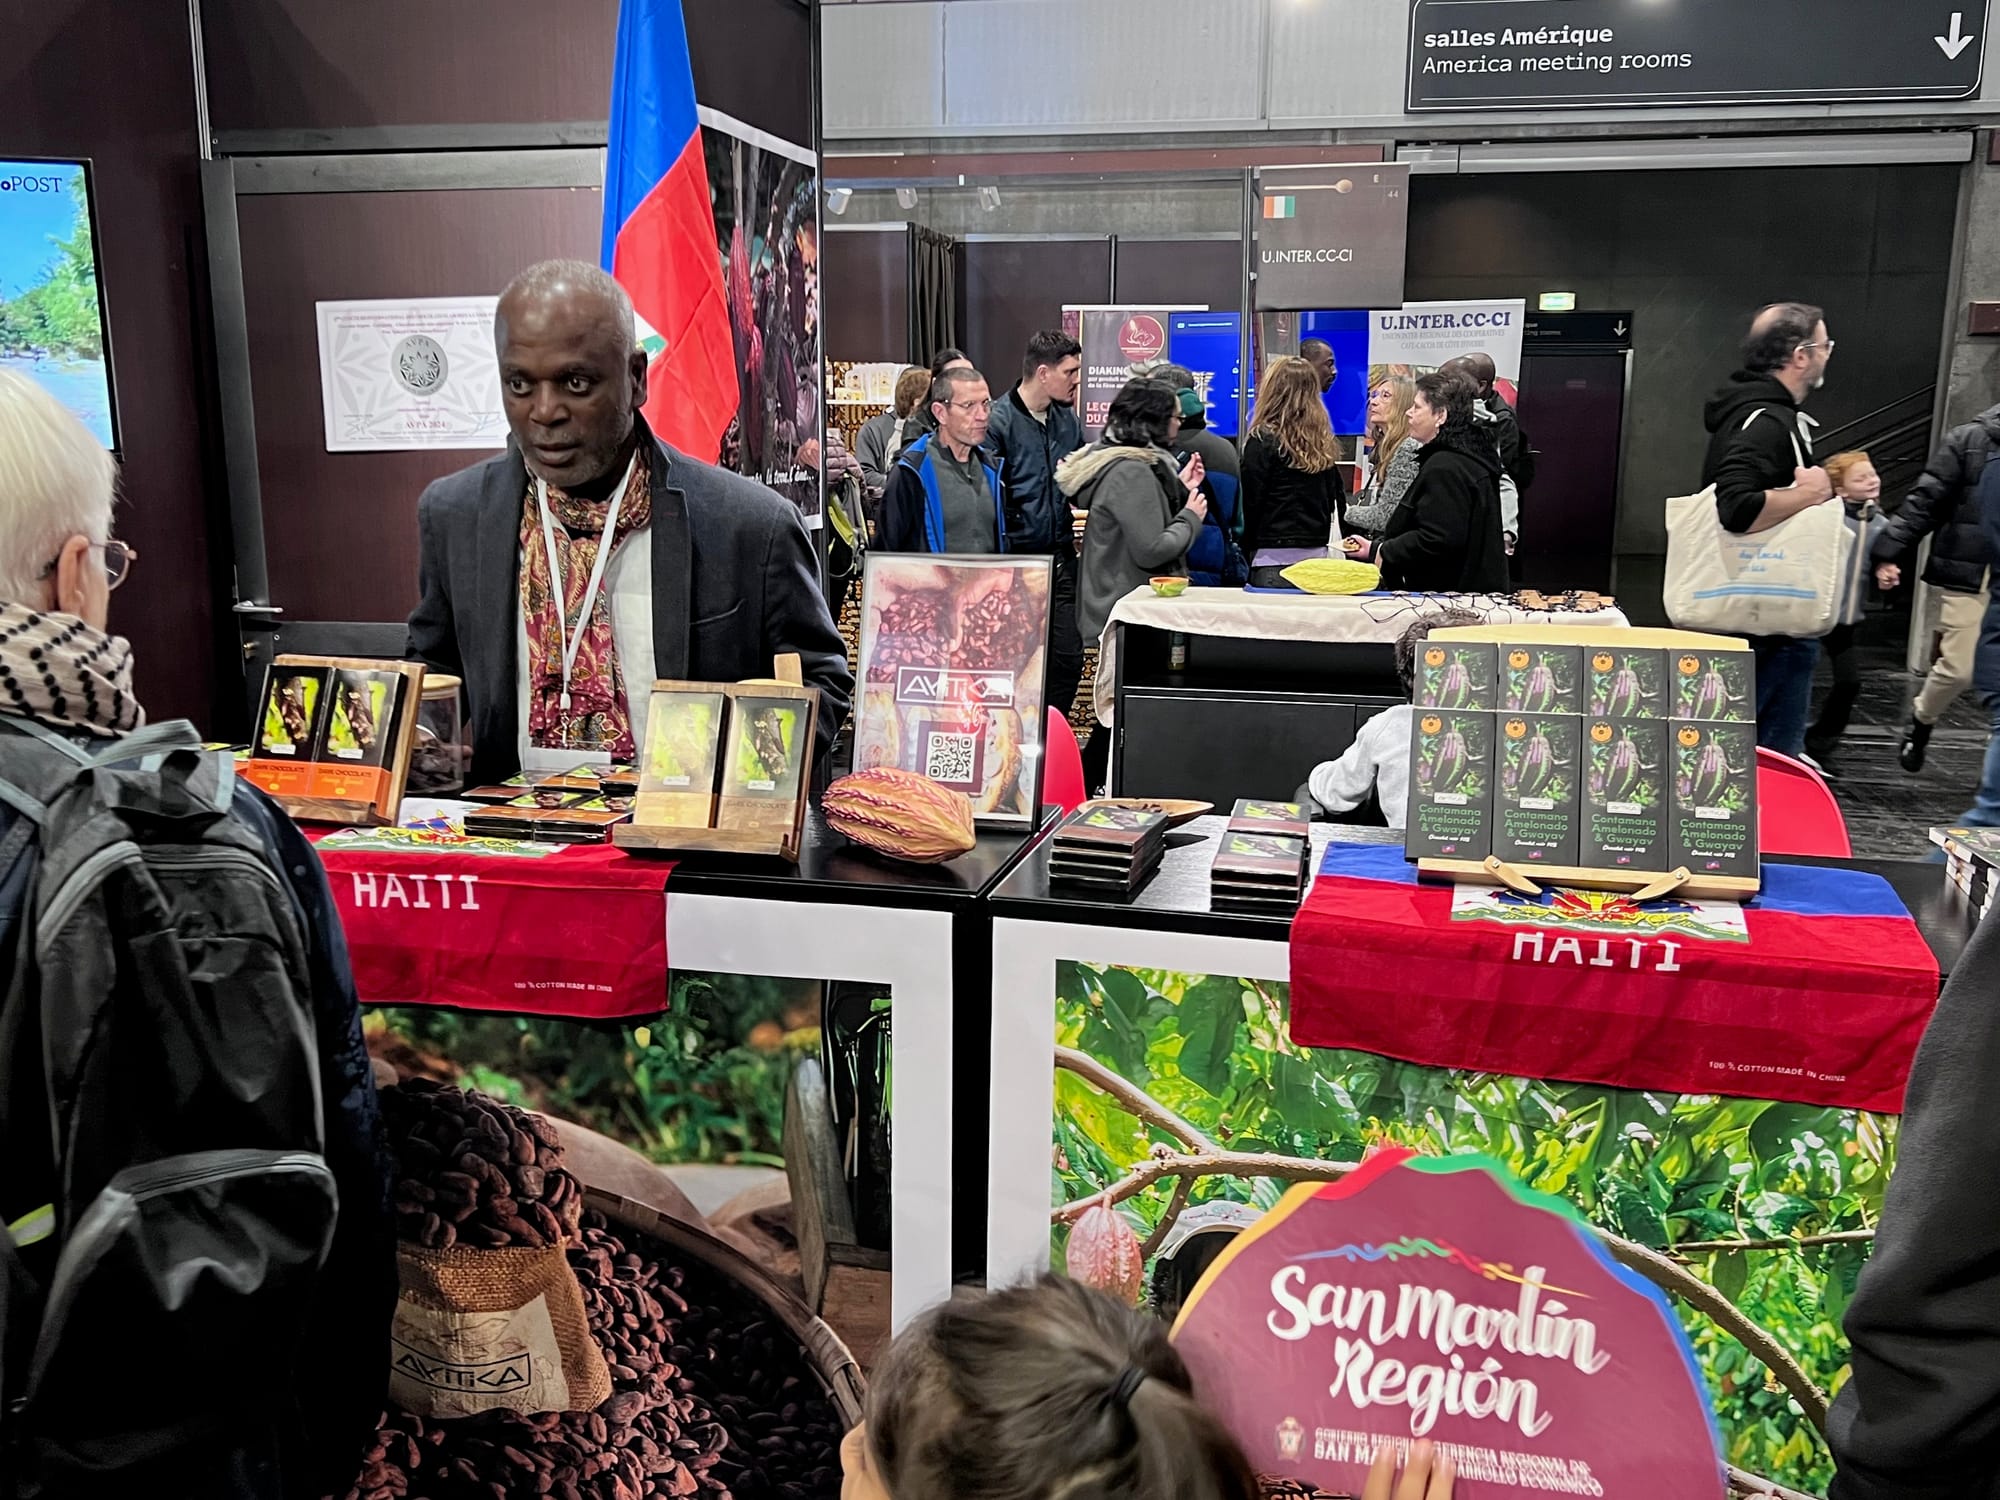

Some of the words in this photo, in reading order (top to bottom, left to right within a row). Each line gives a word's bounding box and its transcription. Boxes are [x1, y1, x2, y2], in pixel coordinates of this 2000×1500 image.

[1424, 29, 1496, 48] salles
[1500, 25, 1613, 47] Amérique
[1422, 55, 1512, 74] America
[1519, 52, 1613, 74] meeting
[1619, 51, 1692, 70] rooms
[1373, 174, 1380, 184] E
[1262, 248, 1354, 264] U.INTER.CC-CI
[1380, 311, 1512, 331] U.INTER.CC-CI
[1087, 402, 1099, 411] LE
[1086, 414, 1101, 423] DU
[1418, 804, 1481, 816] Contamana
[1504, 809, 1568, 821] Contamana
[1418, 813, 1481, 825] Amelonado
[1504, 818, 1568, 830] Amelonado
[1591, 813, 1656, 826] Contamana
[1680, 819, 1746, 831] Contamana
[1421, 823, 1429, 832] &
[1432, 824, 1478, 836] Gwayav
[1506, 828, 1515, 837] &
[1519, 829, 1565, 842] Gwayav
[1591, 823, 1657, 835] Amelonado
[1680, 828, 1746, 841] Amelonado
[1594, 833, 1603, 842] &
[1606, 833, 1653, 847] Gwayav
[1683, 838, 1692, 847] &
[1695, 839, 1743, 852] Gwayav
[351, 871, 481, 911] HAITI
[1512, 931, 1681, 973] HAITI
[566, 982, 585, 990] MADE
[1737, 1064, 1776, 1074] COTTON
[1776, 1066, 1804, 1076] MADE
[1806, 1070, 1817, 1079] IN
[1267, 1265, 1398, 1345] San
[1329, 1336, 1553, 1438] Región
